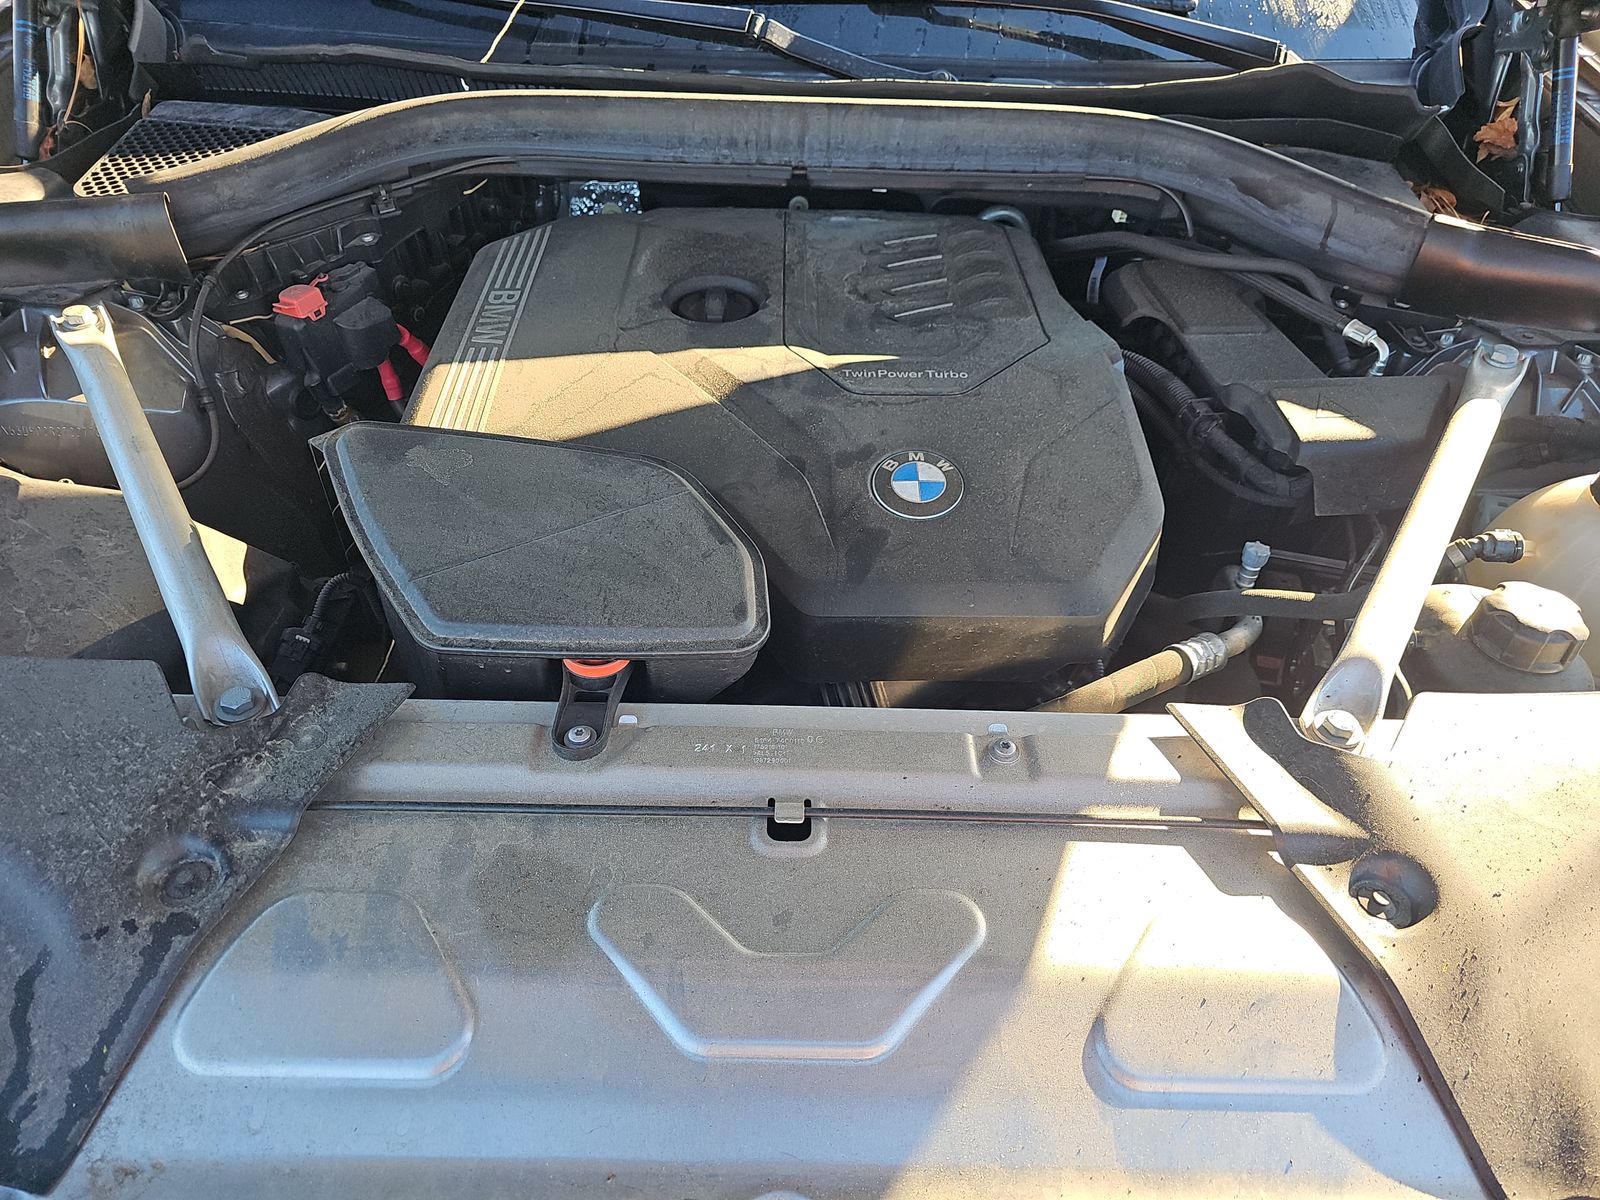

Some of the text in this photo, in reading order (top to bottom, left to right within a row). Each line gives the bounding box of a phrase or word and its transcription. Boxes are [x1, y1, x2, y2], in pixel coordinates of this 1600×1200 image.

[471, 290, 521, 344] BMW
[925, 369, 969, 379] Turbo
[881, 452, 954, 472] BMW
[772, 728, 794, 737] BMW
